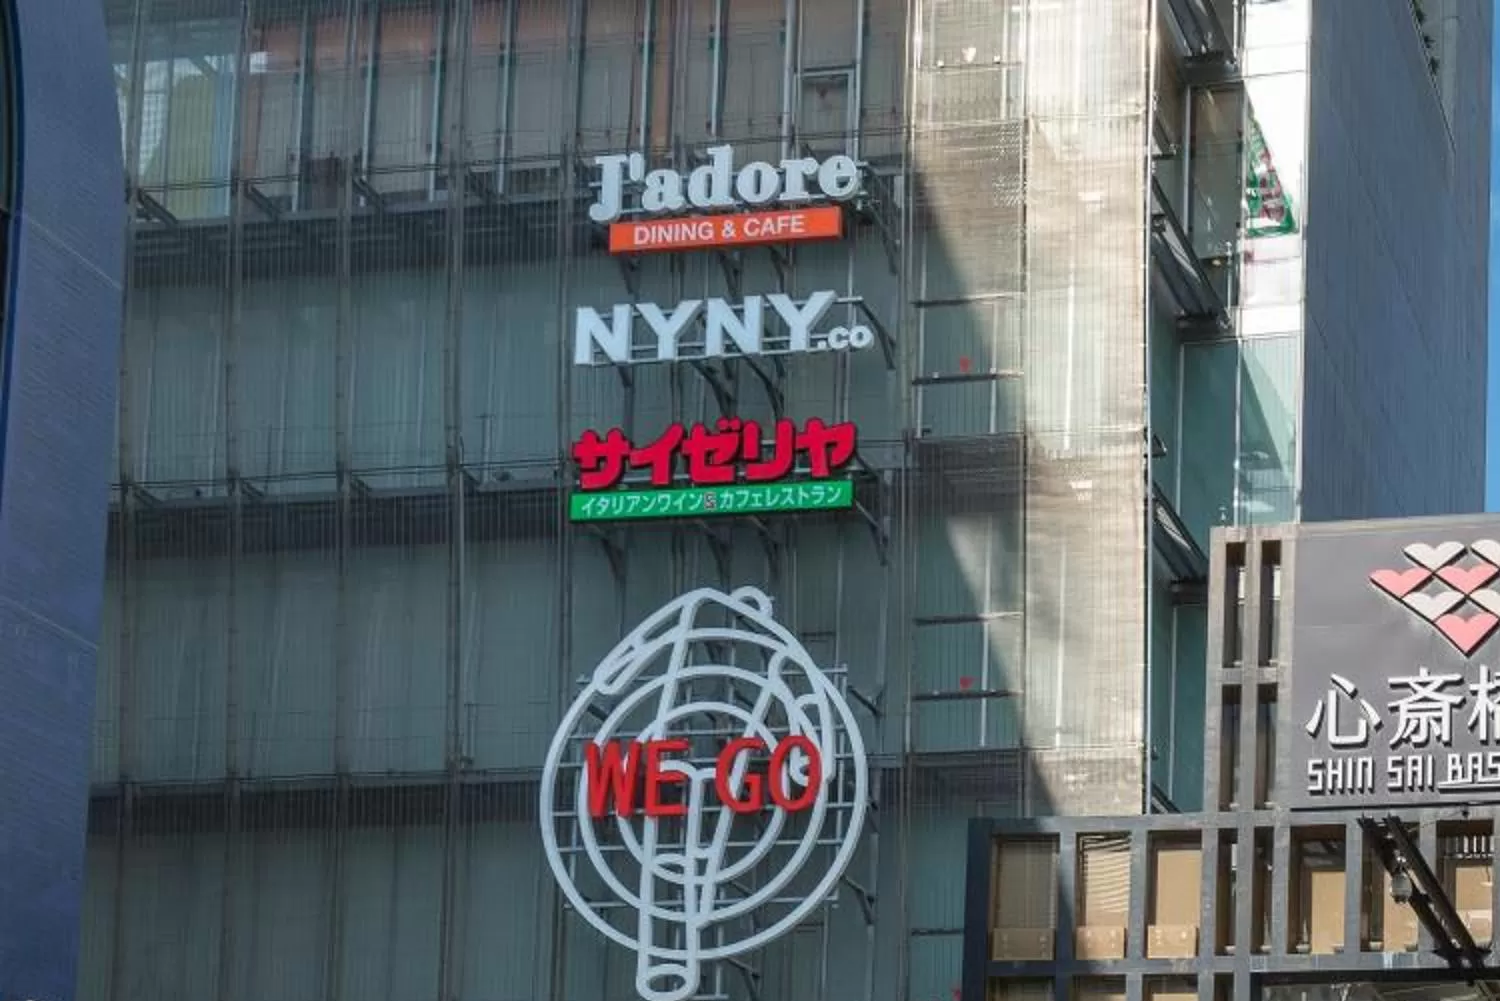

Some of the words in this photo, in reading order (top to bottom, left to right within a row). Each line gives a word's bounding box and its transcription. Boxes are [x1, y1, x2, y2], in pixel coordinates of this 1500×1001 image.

[588, 144, 859, 221] J'adore
[633, 217, 714, 246] DINING
[721, 218, 736, 238] &
[743, 215, 806, 237] CAFE
[574, 289, 874, 366] NYNY.co
[572, 417, 854, 490] サイゼリヤ
[1308, 757, 1374, 795] SHIN
[1388, 755, 1435, 793] SAI
